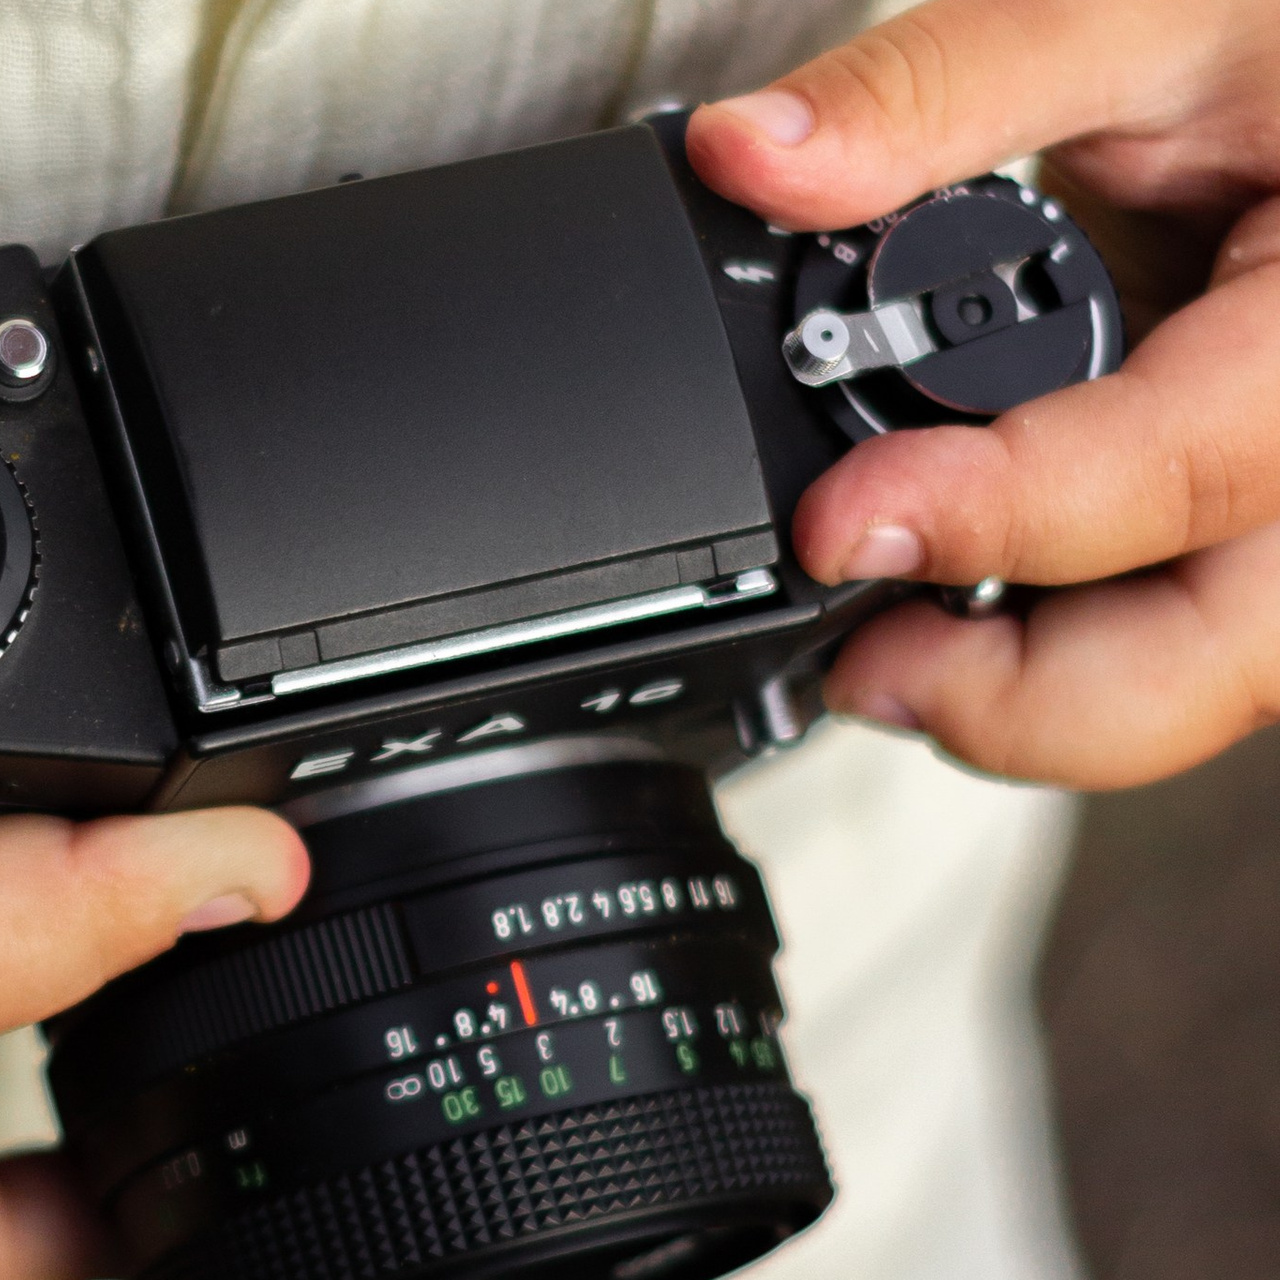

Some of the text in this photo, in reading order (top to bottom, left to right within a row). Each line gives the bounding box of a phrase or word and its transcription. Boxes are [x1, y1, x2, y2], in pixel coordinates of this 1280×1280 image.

[289, 712, 525, 781] EXA
[491, 877, 735, 939] 16 11 8 5.6 4 2.8 1.8
[384, 972, 658, 1059] 16 8 4 4 8 16
[662, 1010, 694, 1039] 1.5
[535, 1032, 554, 1062] 3
[604, 1020, 622, 1047] 2
[477, 1045, 499, 1077] 5
[609, 1053, 626, 1083] 7
[677, 1042, 694, 1071] 5
[428, 1057, 462, 1090] 10
[540, 1066, 572, 1097] 10
[442, 1087, 482, 1122] 30
[495, 1076, 526, 1108] 15
[227, 1128, 247, 1150] m
